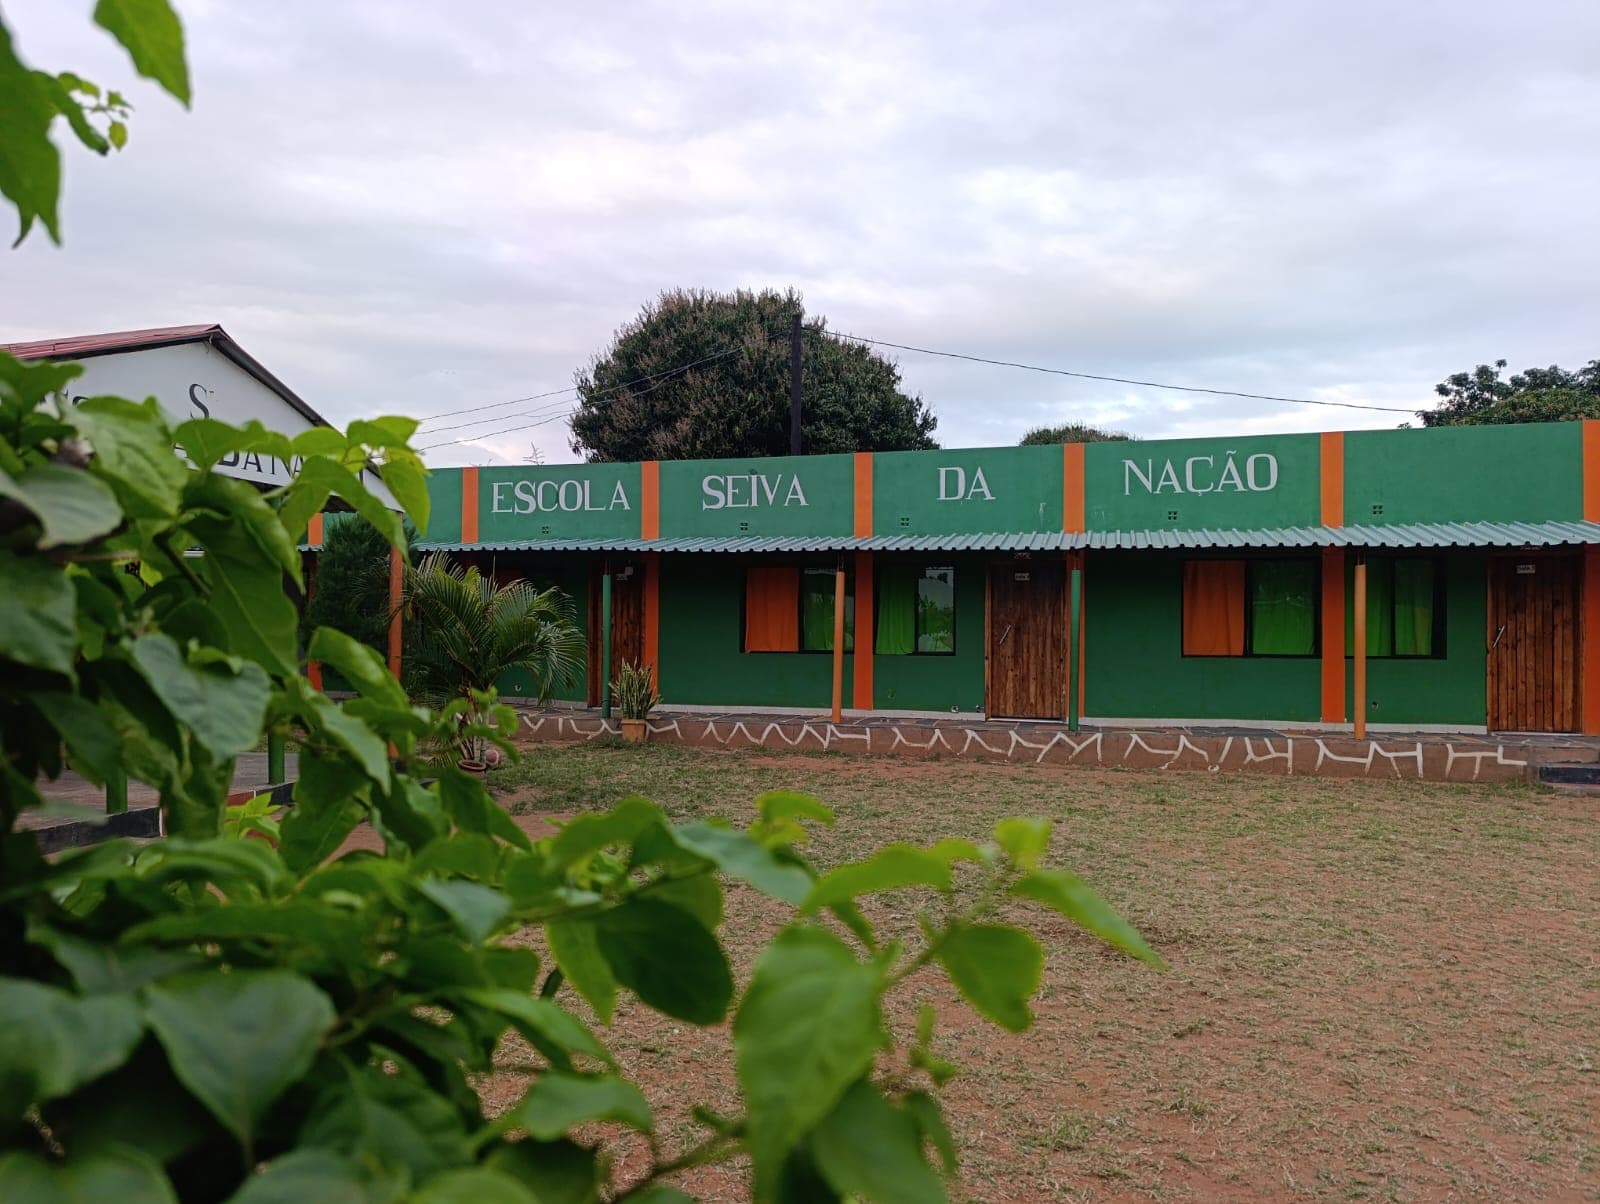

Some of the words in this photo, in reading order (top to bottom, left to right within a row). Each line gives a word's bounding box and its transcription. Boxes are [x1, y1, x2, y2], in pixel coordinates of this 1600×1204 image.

[492, 480, 630, 513] ESCOLA
[703, 475, 808, 510] SEIVA
[938, 467, 995, 500] DA
[1123, 451, 1277, 496] NAÇÃO
